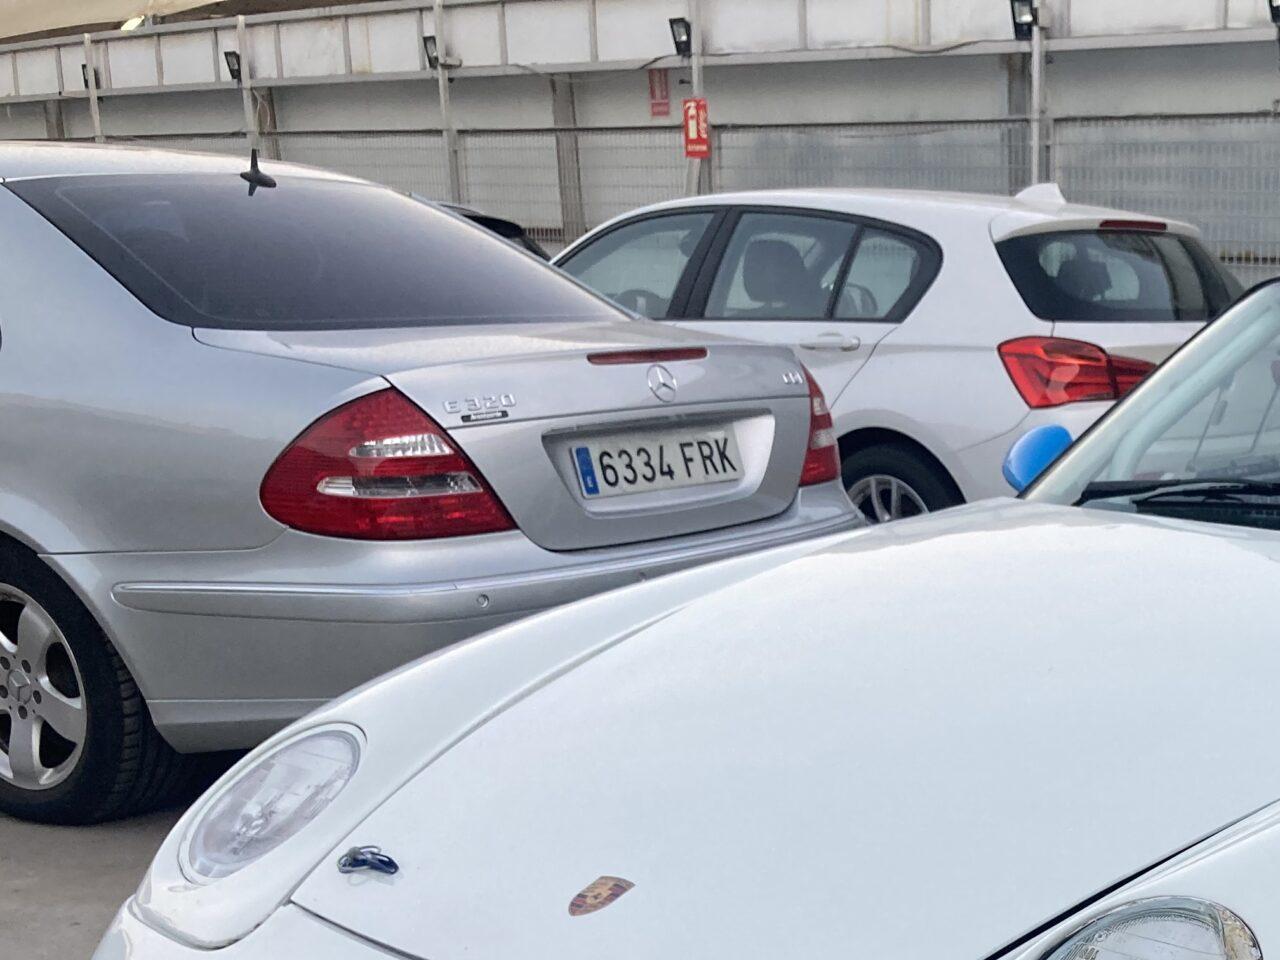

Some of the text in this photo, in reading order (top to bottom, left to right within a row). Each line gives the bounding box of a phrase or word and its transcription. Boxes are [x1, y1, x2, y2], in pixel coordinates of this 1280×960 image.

[465, 394, 516, 411] 320
[599, 438, 737, 487] 6334 FRK
